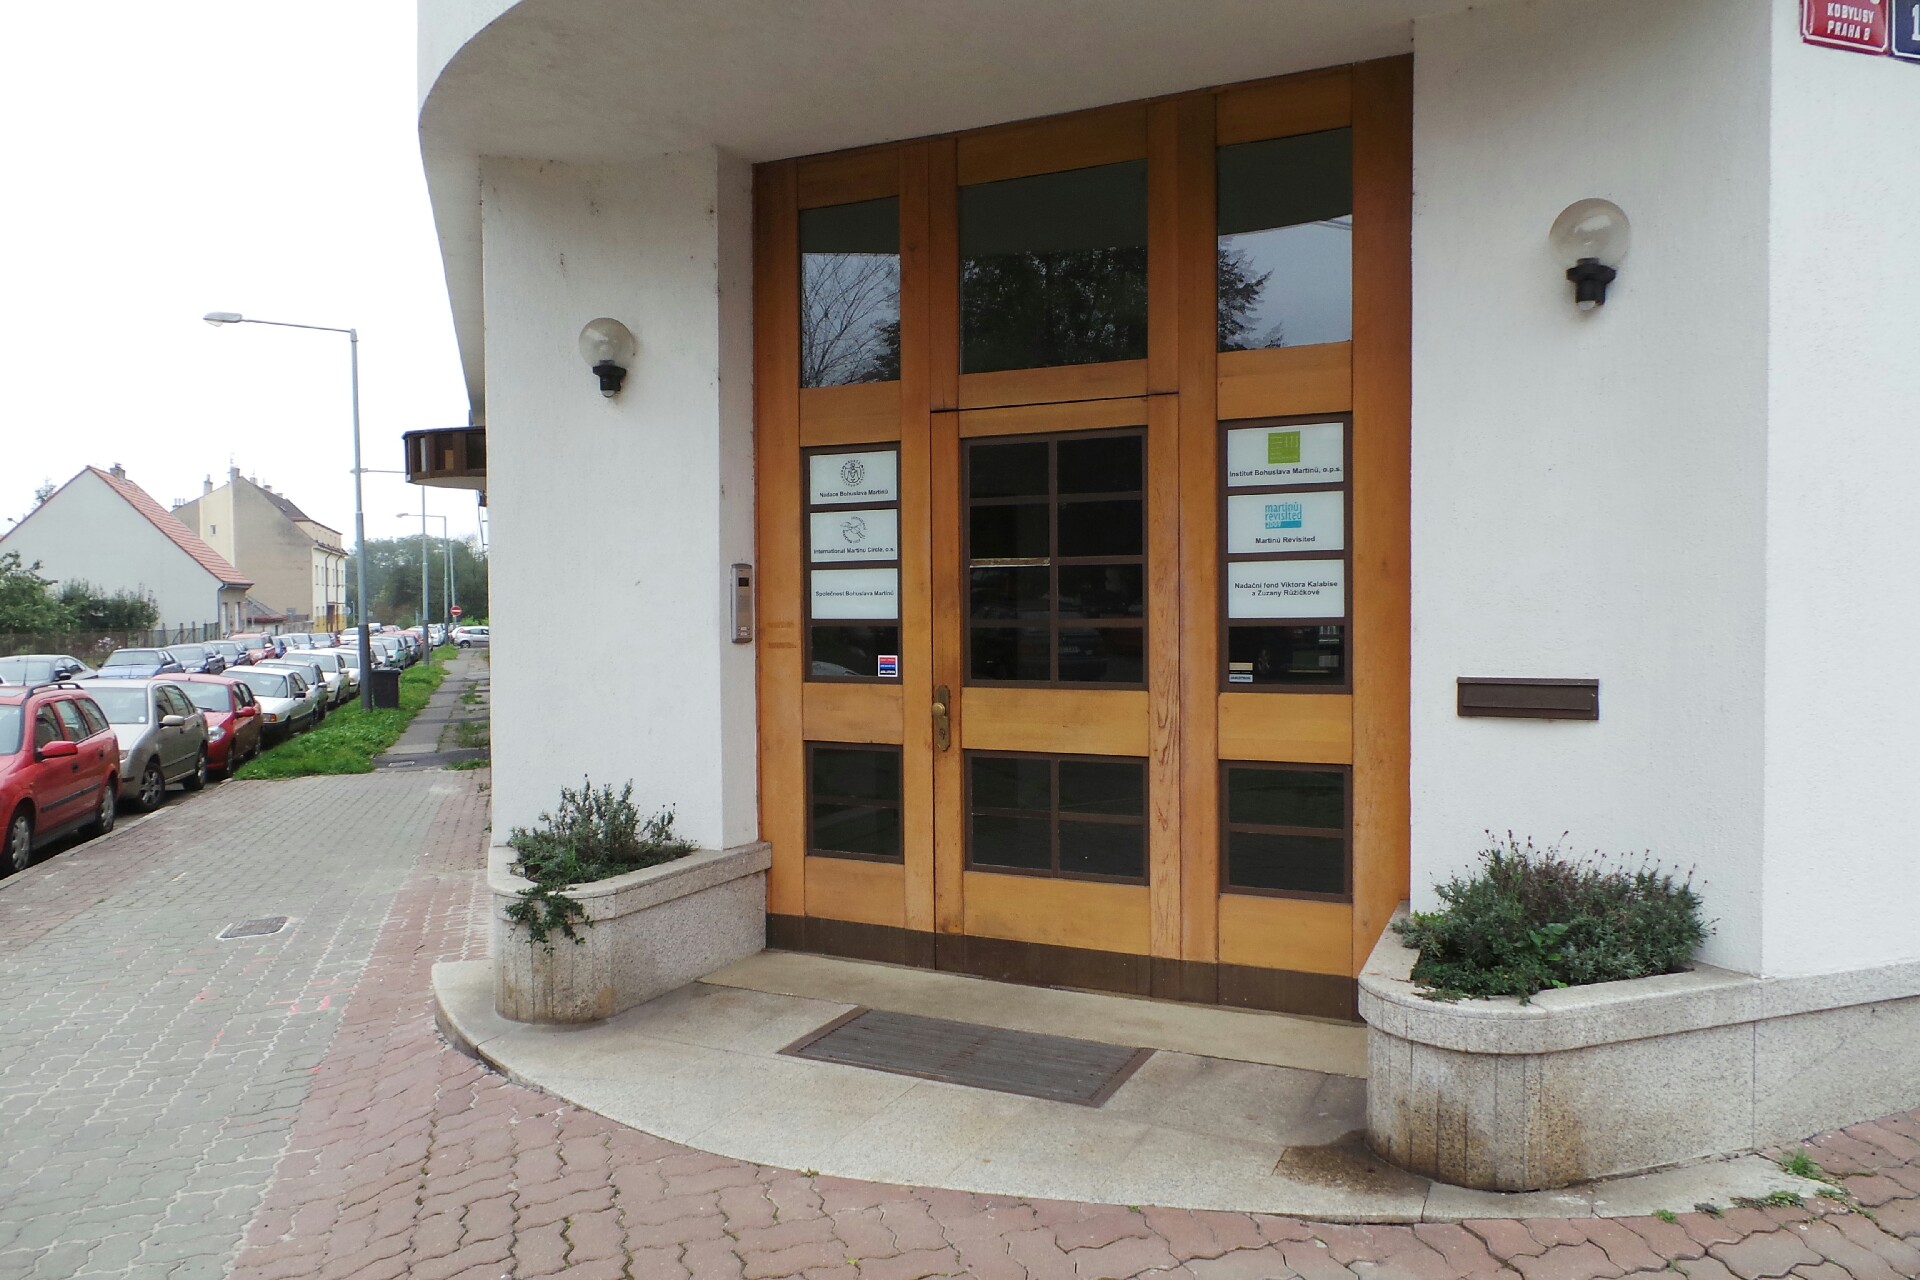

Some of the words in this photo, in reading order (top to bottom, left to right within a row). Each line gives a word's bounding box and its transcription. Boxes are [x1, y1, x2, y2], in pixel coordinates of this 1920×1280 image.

[1827, 2, 1874, 24] KOBYLISY
[1827, 20, 1861, 39] PRAHA
[839, 489, 867, 497] Bohuslava
[1282, 535, 1316, 543] Revisited
[1257, 589, 1282, 597] Zuzany
